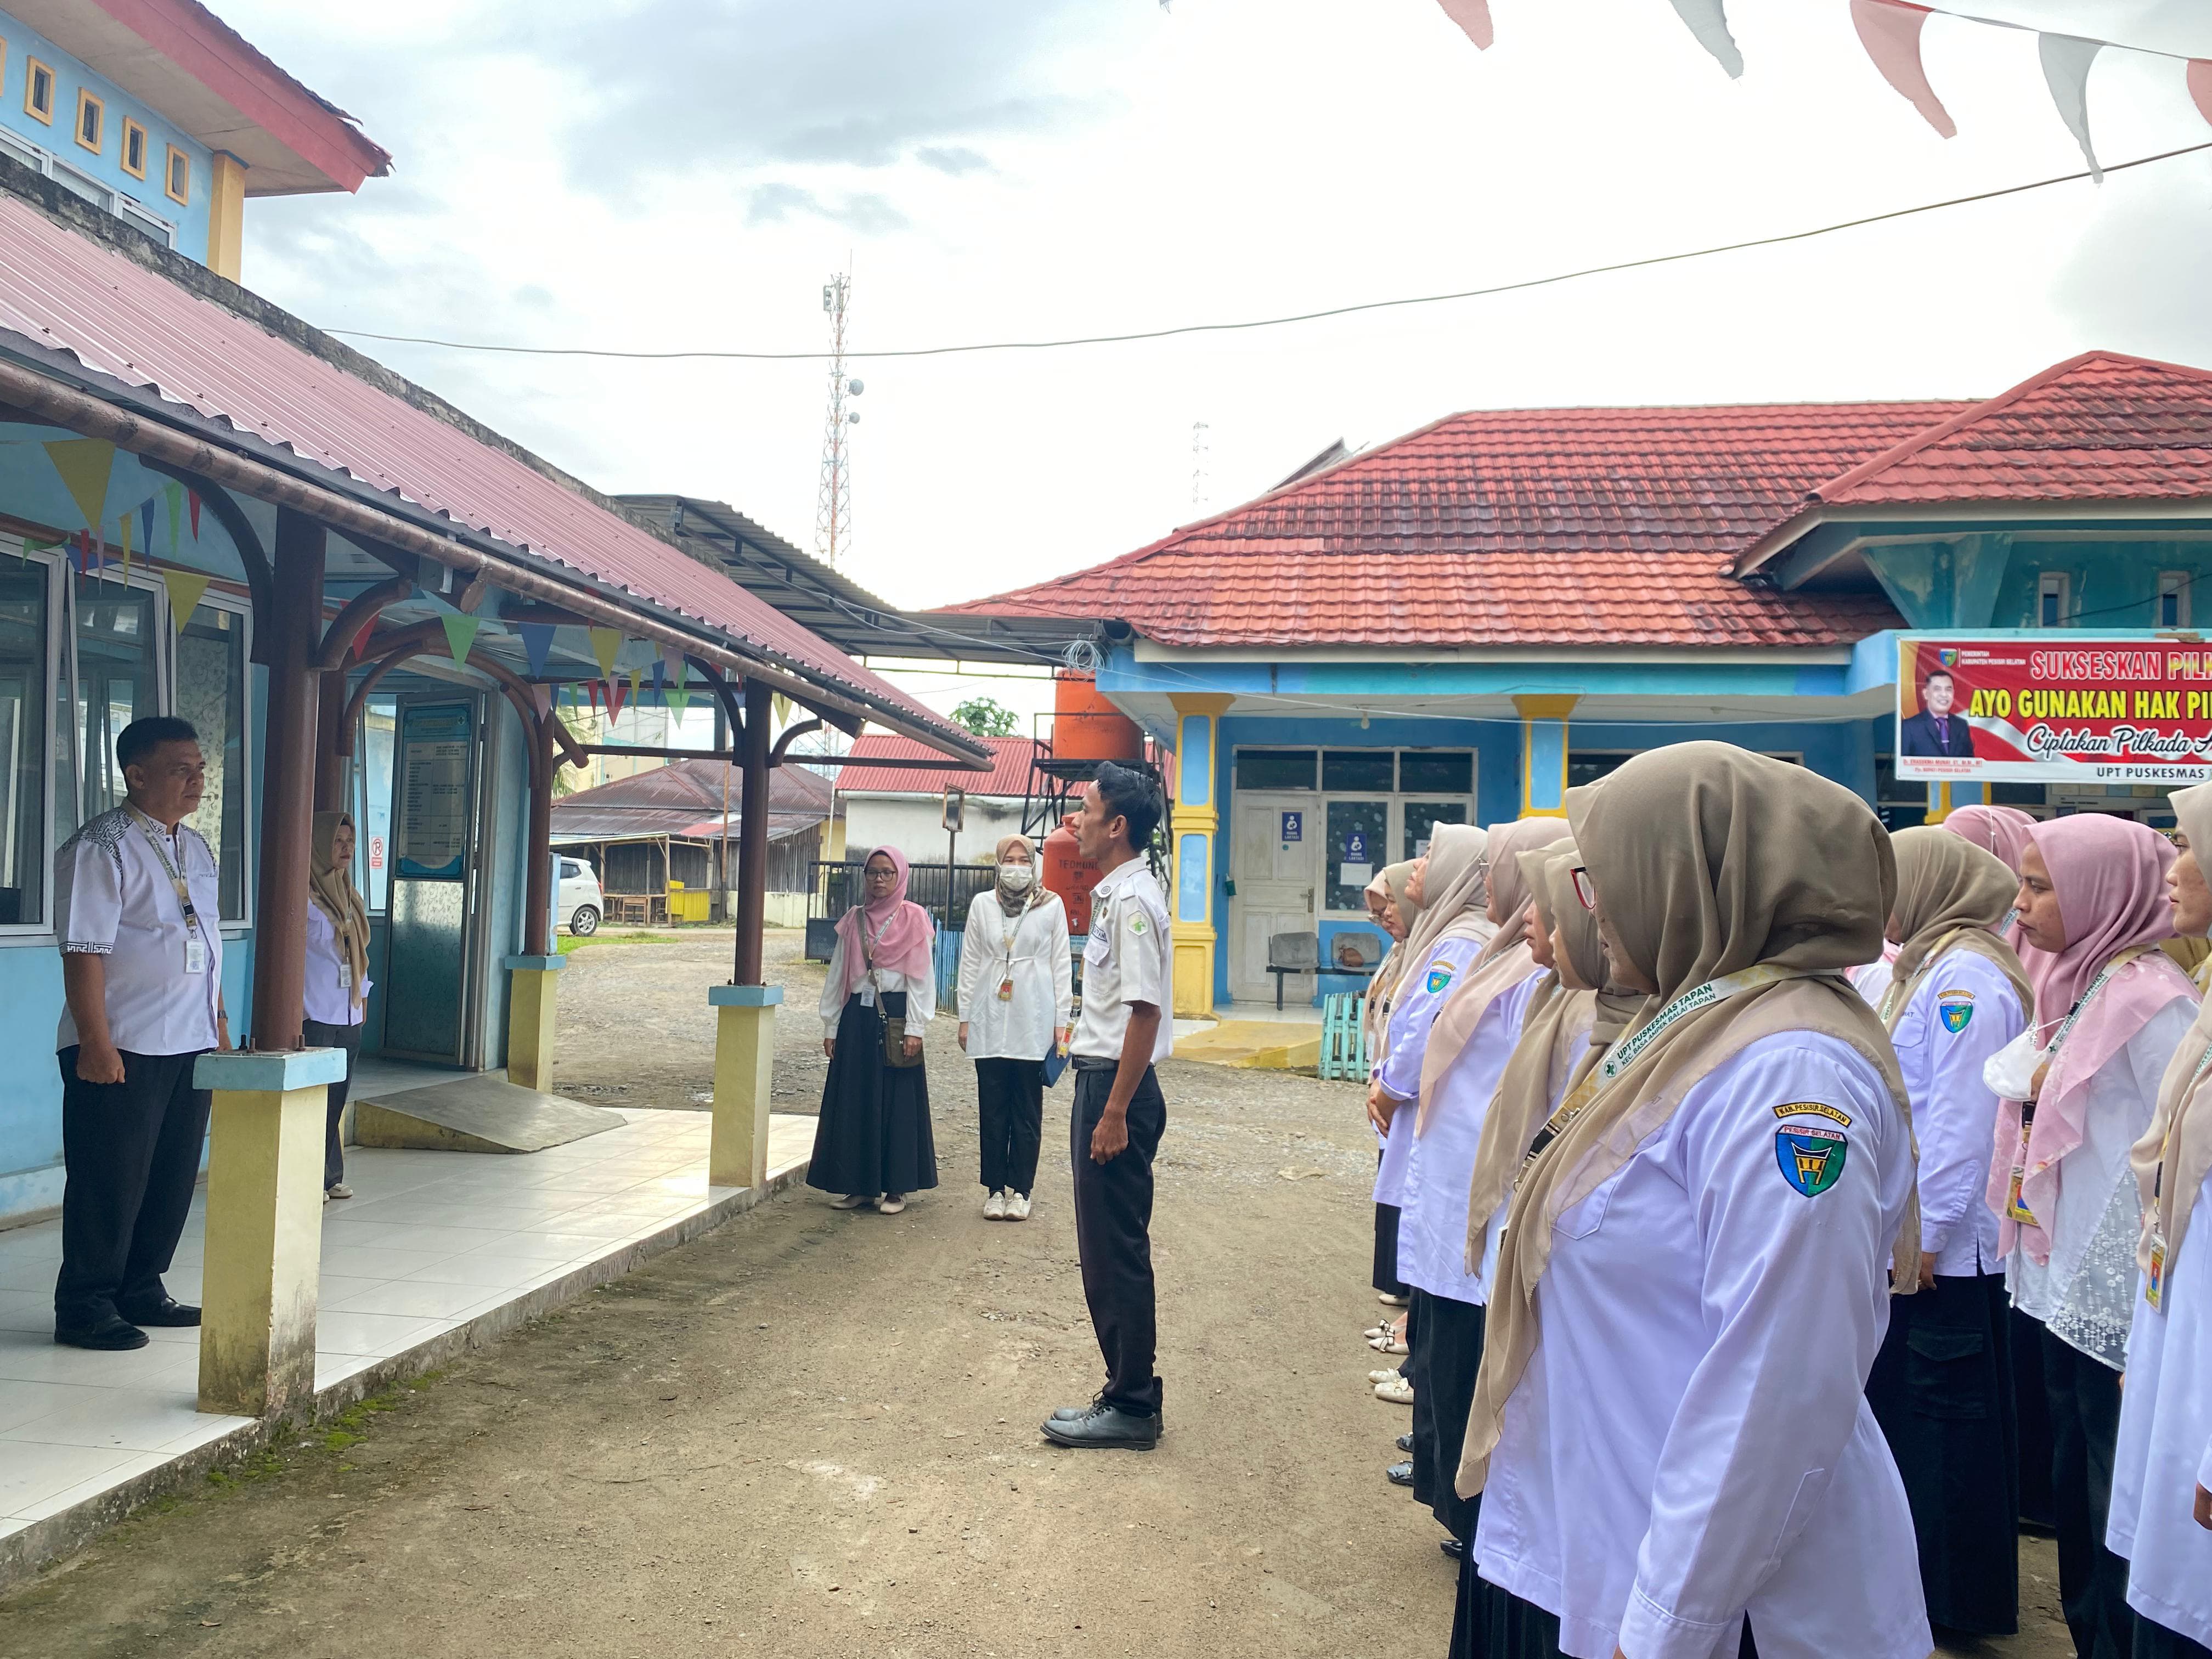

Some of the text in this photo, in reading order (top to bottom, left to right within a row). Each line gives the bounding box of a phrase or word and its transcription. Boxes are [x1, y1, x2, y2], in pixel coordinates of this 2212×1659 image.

[2030, 651, 2162, 681] SUKSESKAN
[1968, 689, 2212, 720] AYO GUNAKAN HAK PI
[2027, 725, 2112, 759] Ciptakan
[2112, 726, 2192, 754] Pilkada
[2097, 767, 2205, 778] UPT PUSKESMAS
[1617, 984, 1713, 1059] UPT PUSKESMAS TAPAN
[1622, 993, 1716, 1066] KEC. BASA AMPEK BALAI TAPAN
[1820, 1106, 1847, 1122] SELATAN
[1784, 1127, 1841, 1140] PESISIR SELATAN
